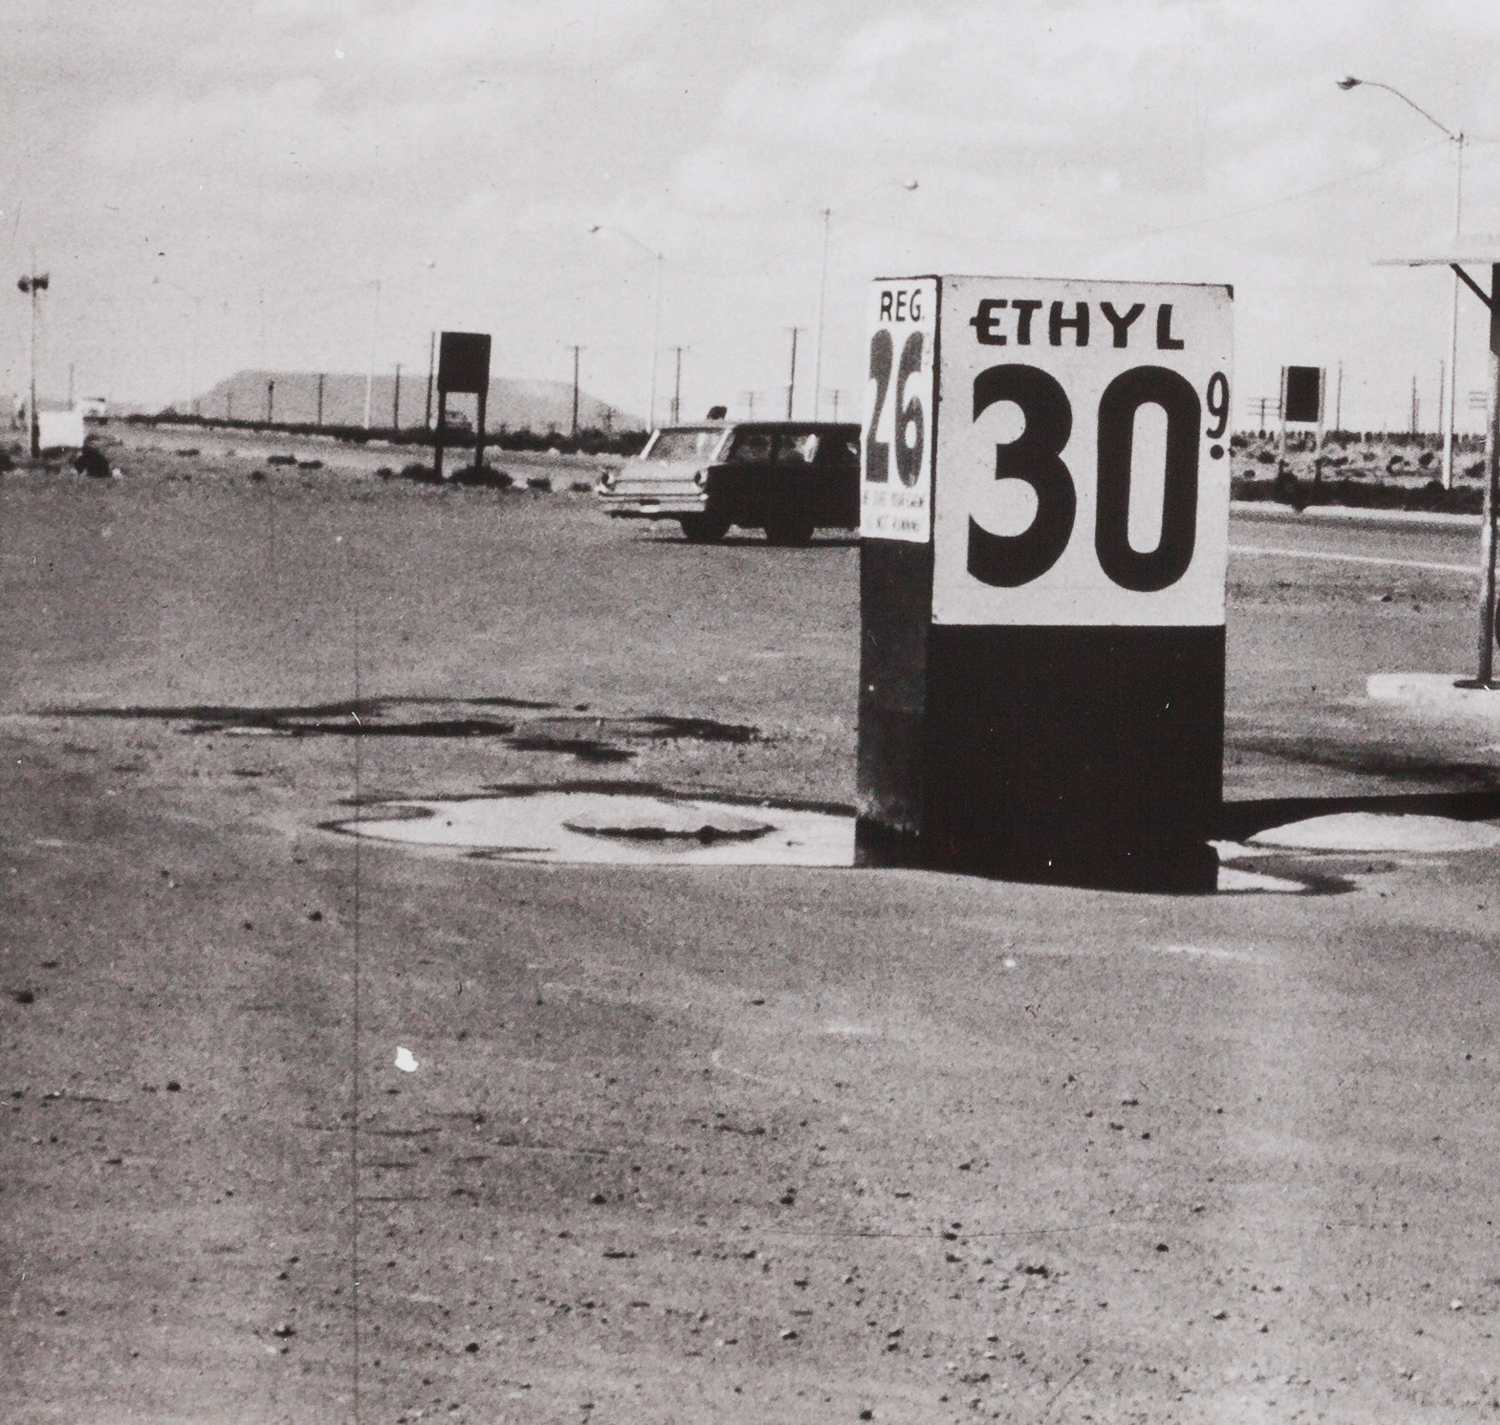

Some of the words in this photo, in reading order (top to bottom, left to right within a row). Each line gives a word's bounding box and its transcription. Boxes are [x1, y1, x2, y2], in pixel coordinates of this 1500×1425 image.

[969, 297, 1185, 351] ETHYL
[865, 328, 924, 488] 26
[966, 363, 1202, 593] 30
